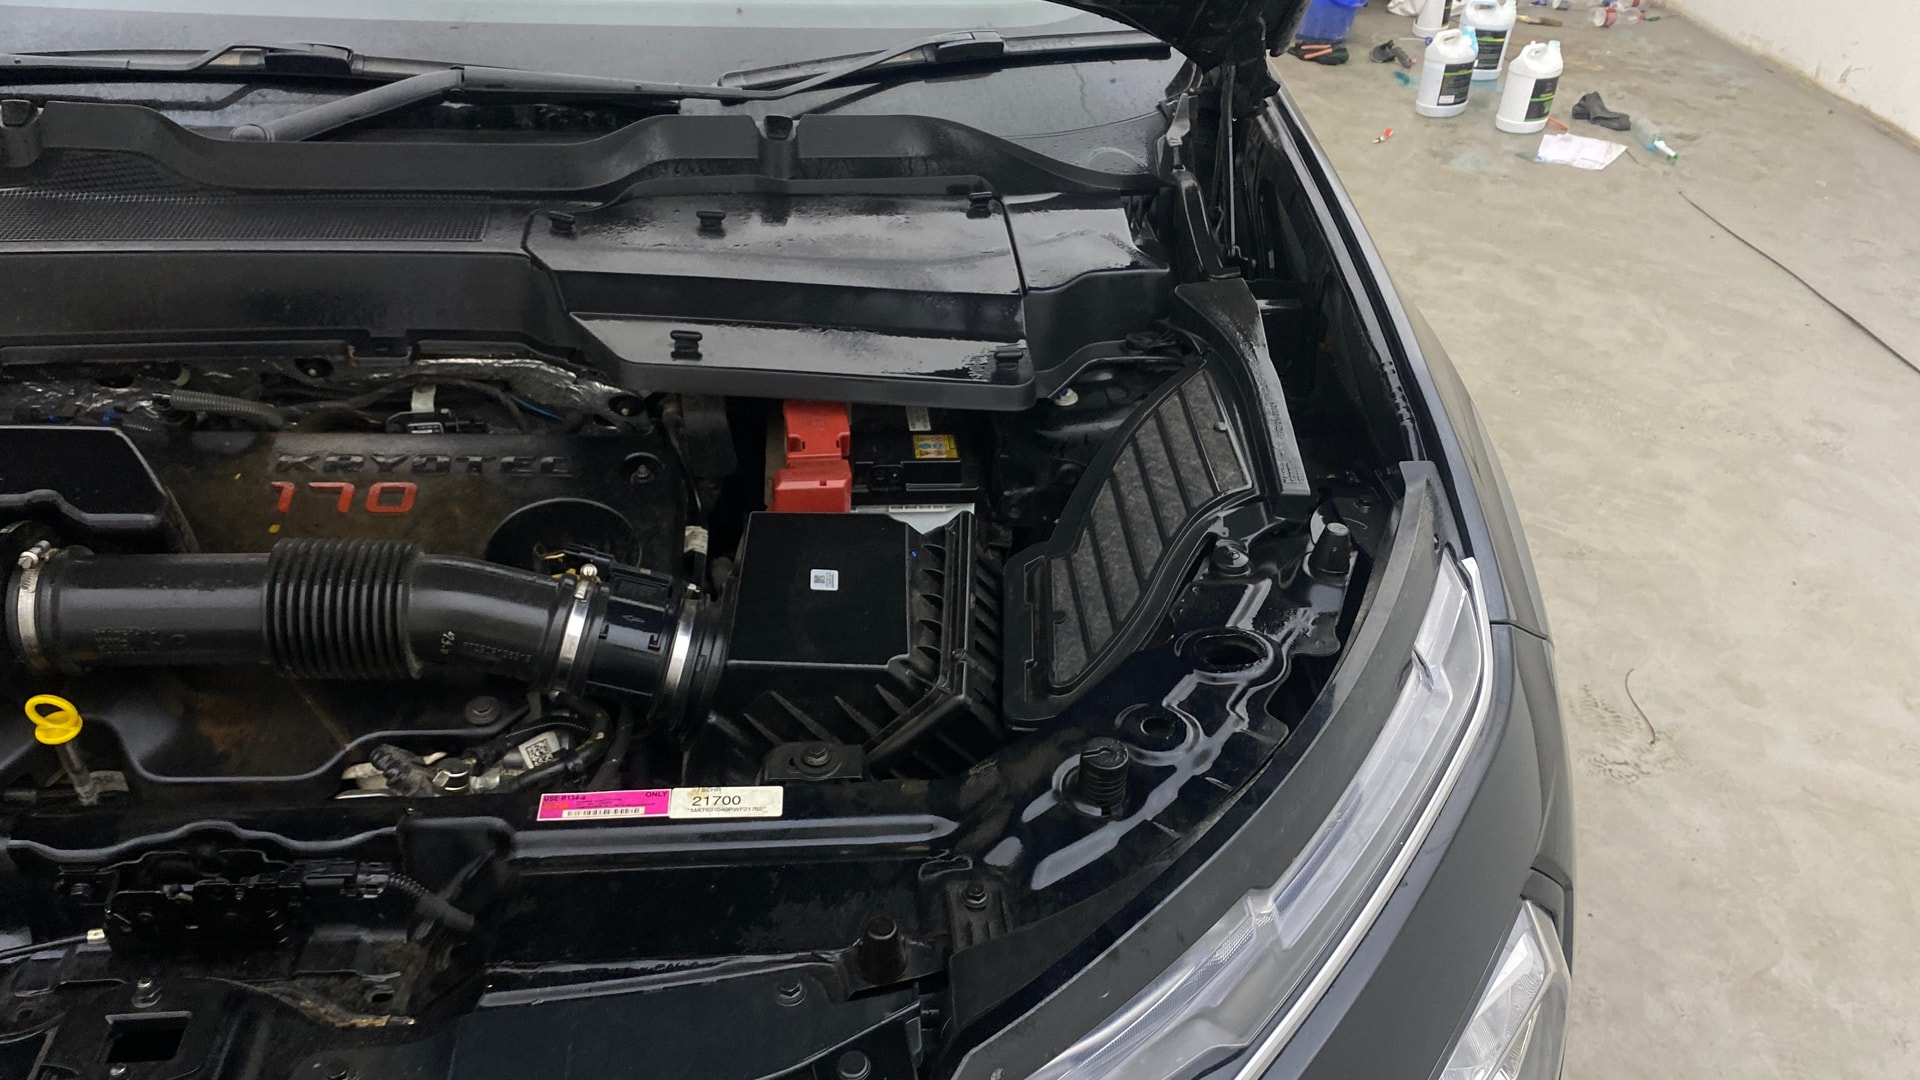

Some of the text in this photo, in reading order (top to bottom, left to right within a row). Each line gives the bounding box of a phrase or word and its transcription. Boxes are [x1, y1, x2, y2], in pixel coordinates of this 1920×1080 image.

[276, 454, 572, 477] KRYOTEC
[270, 480, 419, 513] 170
[645, 790, 668, 798] ONLY
[691, 795, 742, 807] 21700
